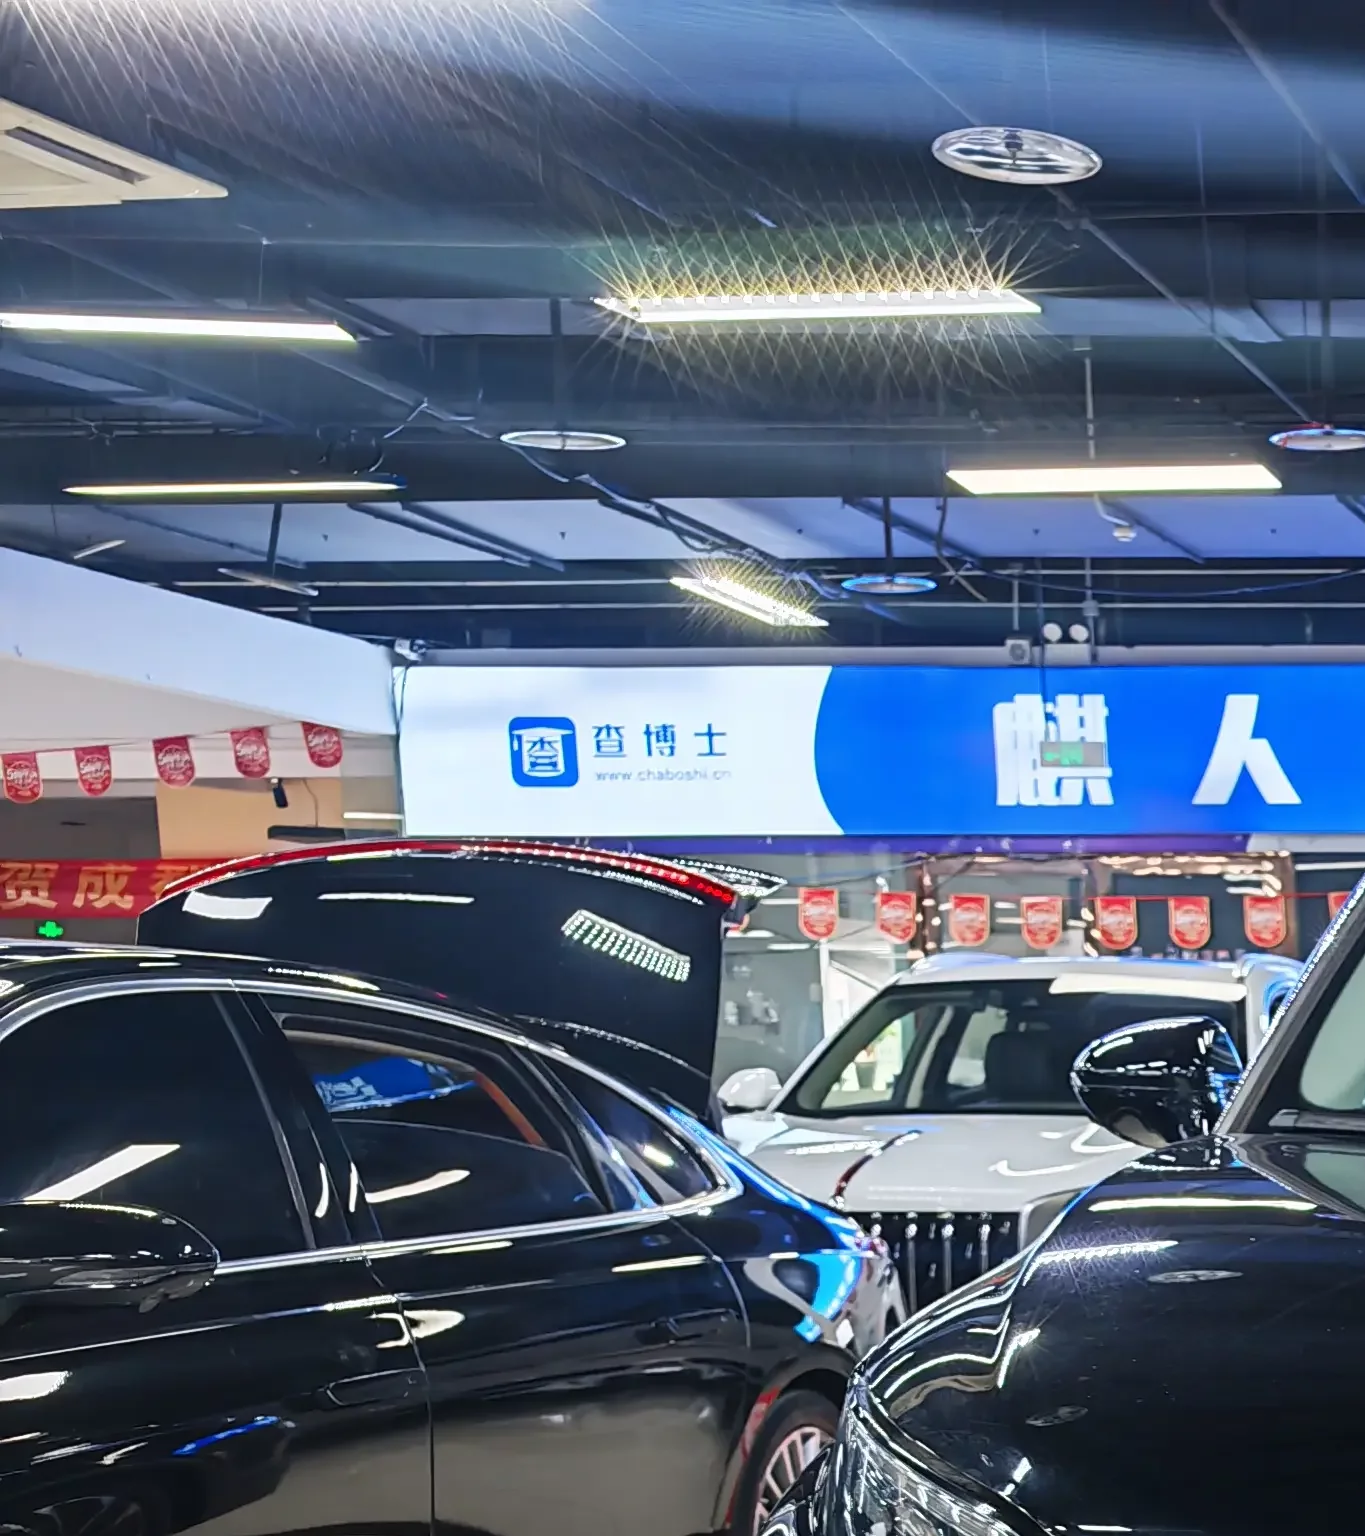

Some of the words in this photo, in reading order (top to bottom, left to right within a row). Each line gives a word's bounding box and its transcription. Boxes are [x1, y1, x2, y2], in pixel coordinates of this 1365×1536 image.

[591, 723, 729, 758] 查博士
[594, 769, 732, 782] www.chaboshi.cn
